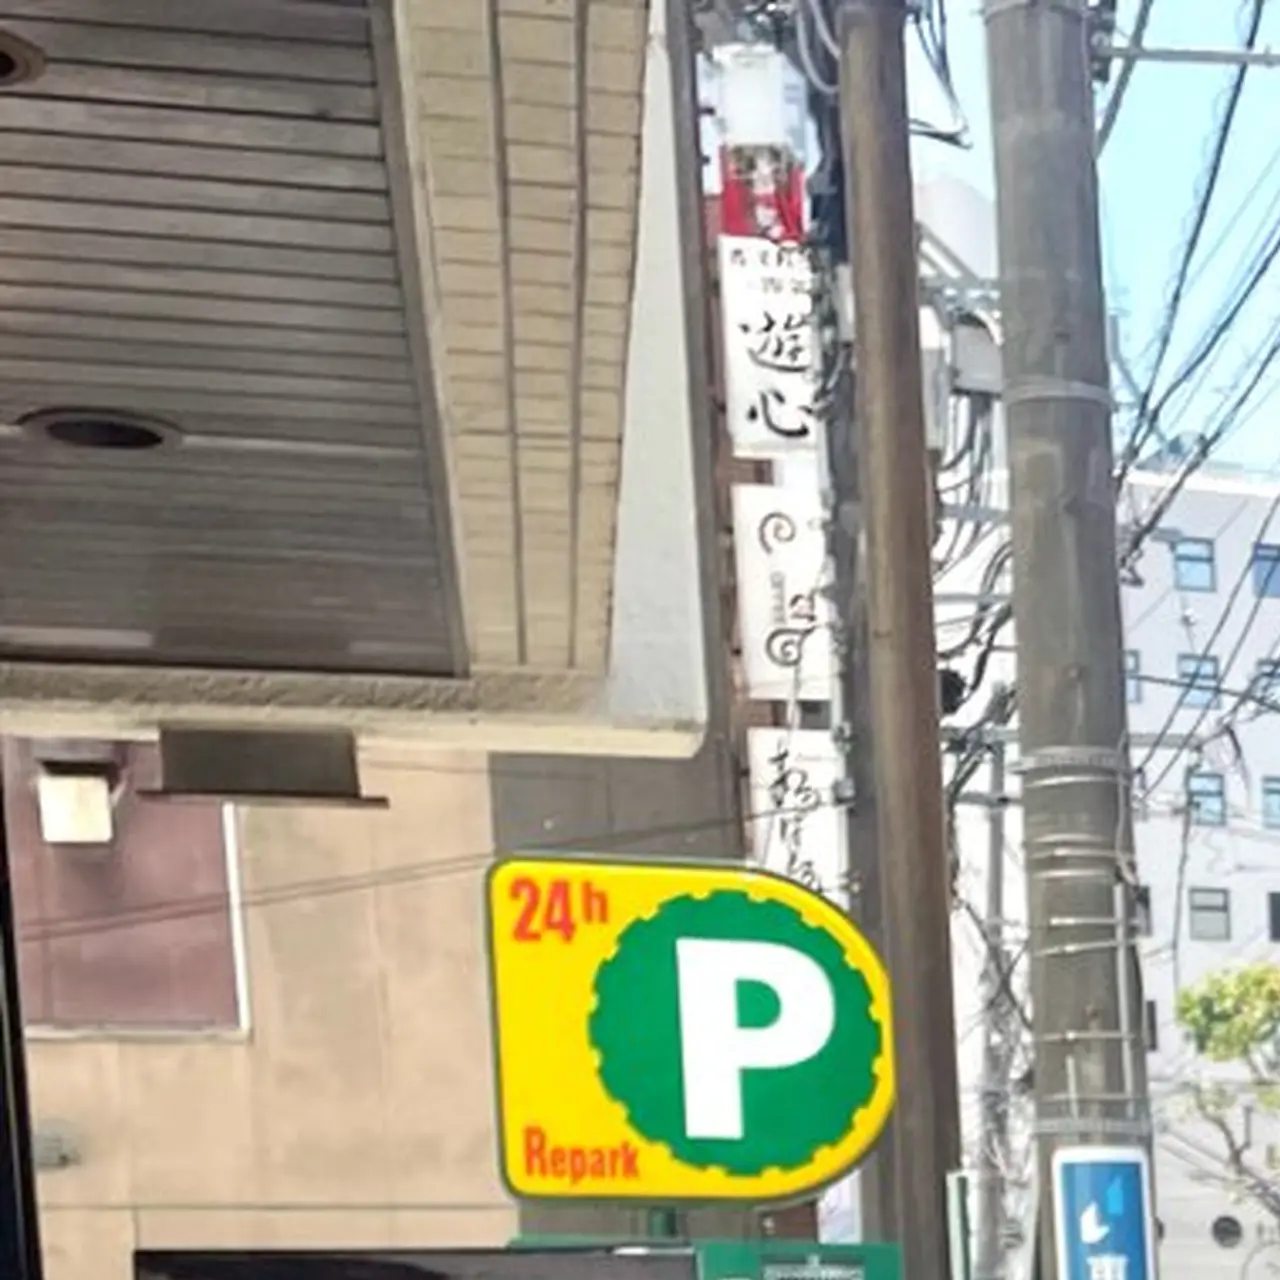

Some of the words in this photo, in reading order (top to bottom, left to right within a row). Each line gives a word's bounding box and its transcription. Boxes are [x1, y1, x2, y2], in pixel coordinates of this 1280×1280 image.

[510, 876, 609, 943] 24h
[676, 937, 836, 1140] P
[523, 1125, 639, 1184] Repark
